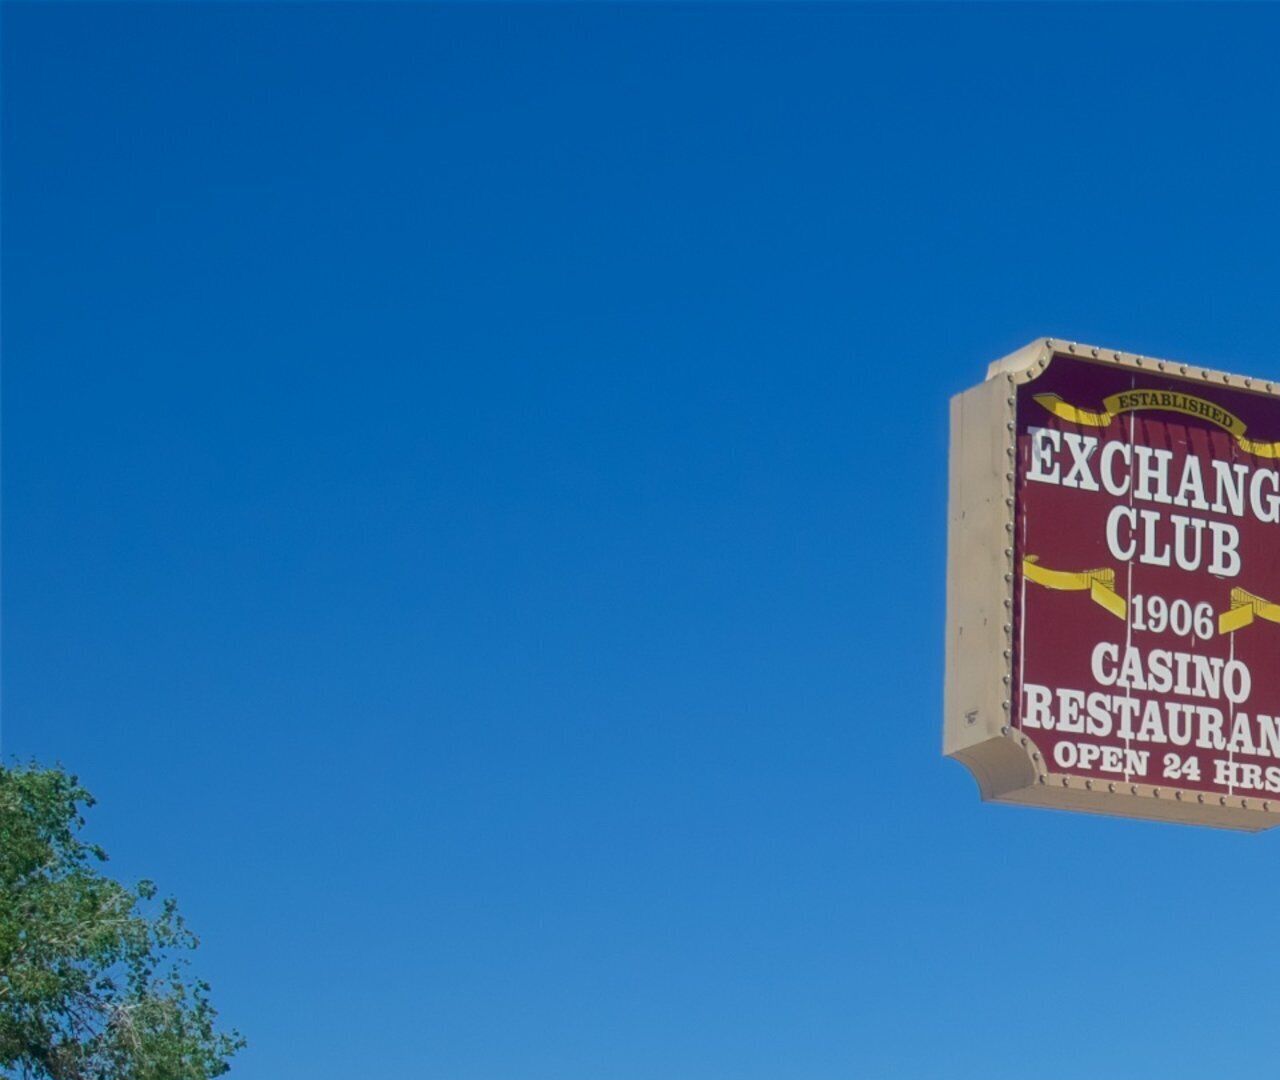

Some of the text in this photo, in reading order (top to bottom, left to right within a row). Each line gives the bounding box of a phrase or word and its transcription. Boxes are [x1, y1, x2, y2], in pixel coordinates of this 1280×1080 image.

[1118, 392, 1233, 428] ESTABLISHED
[1105, 504, 1242, 577] CLUB
[1131, 594, 1215, 640] 1906
[1091, 642, 1252, 704] CASINO
[1053, 740, 1150, 777] OPEN
[1163, 751, 1201, 782] 24
